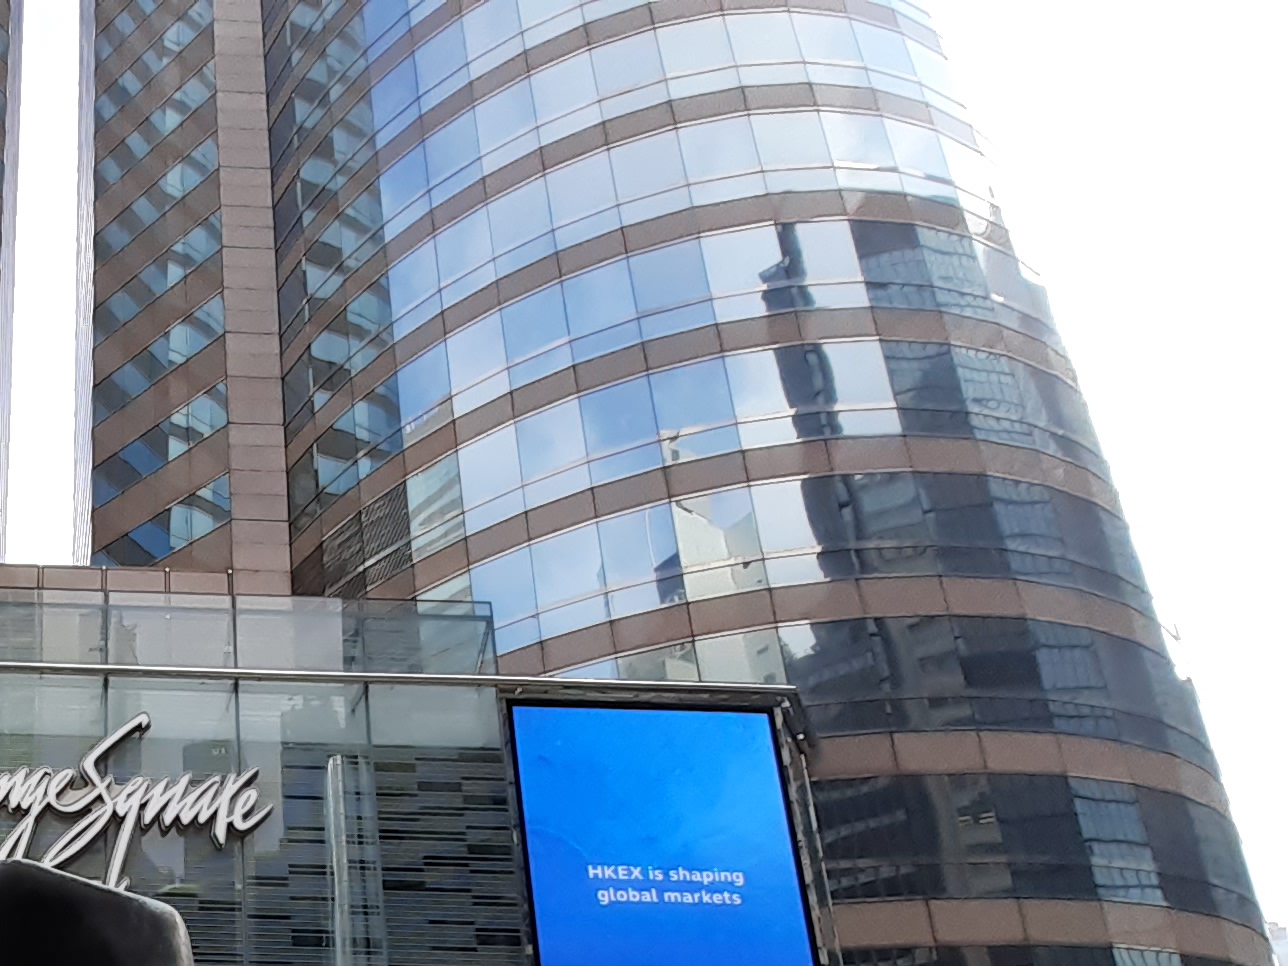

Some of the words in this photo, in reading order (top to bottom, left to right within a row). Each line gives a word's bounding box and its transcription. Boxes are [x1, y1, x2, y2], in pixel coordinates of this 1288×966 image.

[42, 711, 274, 892] Square
[587, 865, 644, 880] HKEX
[648, 866, 663, 881] is
[669, 867, 744, 886] shaping
[597, 888, 659, 905] global
[664, 889, 742, 904] markets
